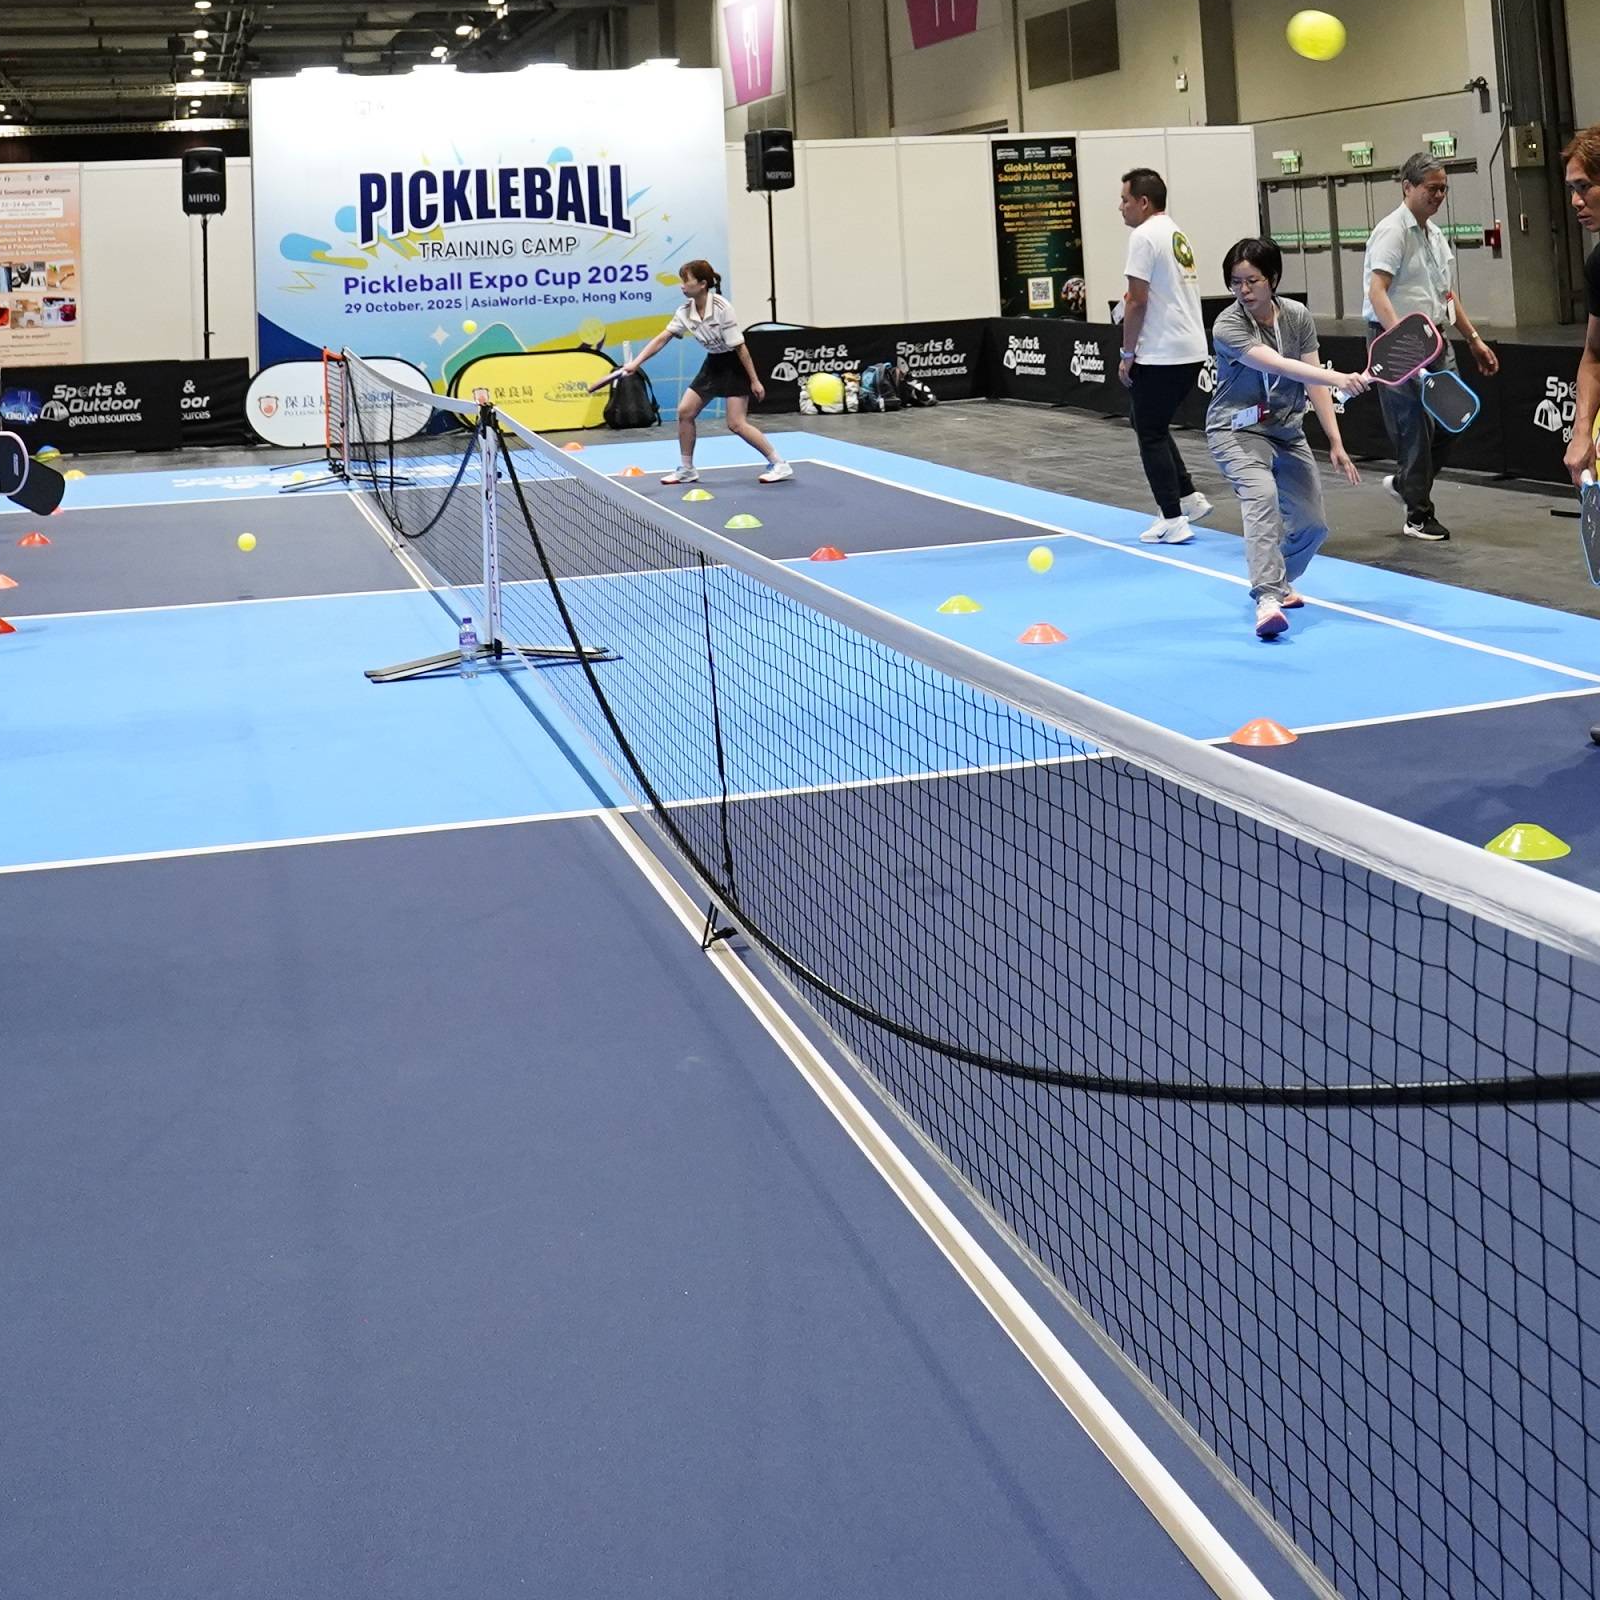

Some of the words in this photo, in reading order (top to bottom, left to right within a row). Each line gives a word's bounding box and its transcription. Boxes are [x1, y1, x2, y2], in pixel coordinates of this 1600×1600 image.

[1004, 162, 1032, 172] Global
[1033, 162, 1066, 171] Sources
[766, 170, 792, 180] MIPRO
[998, 173, 1021, 183] Saudi
[1023, 172, 1050, 181] Arabia
[1052, 171, 1073, 181] Expo
[188, 193, 220, 203] MIPRO
[360, 165, 631, 244] PICKLEBALL
[419, 239, 514, 259] TRAINING
[522, 236, 577, 255] CAMP
[344, 272, 462, 295] Pickleball
[469, 270, 528, 293] Expo
[535, 268, 581, 290] Cup
[588, 264, 649, 284] 2025
[345, 302, 362, 314] 29
[427, 298, 462, 310] 2025
[582, 291, 616, 305] Hong
[620, 290, 652, 303] Kong
[783, 345, 835, 362] Sports
[836, 344, 848, 358] &
[896, 339, 943, 356] Sports
[944, 338, 955, 351] &
[908, 352, 967, 368] Outdoor
[1015, 350, 1046, 365] Outdoor
[798, 359, 861, 374] Outdoor
[53, 383, 112, 401] Sports
[114, 381, 127, 396] &
[69, 398, 141, 413] Outdoor
[68, 414, 98, 427] global
[104, 412, 142, 424] sources
